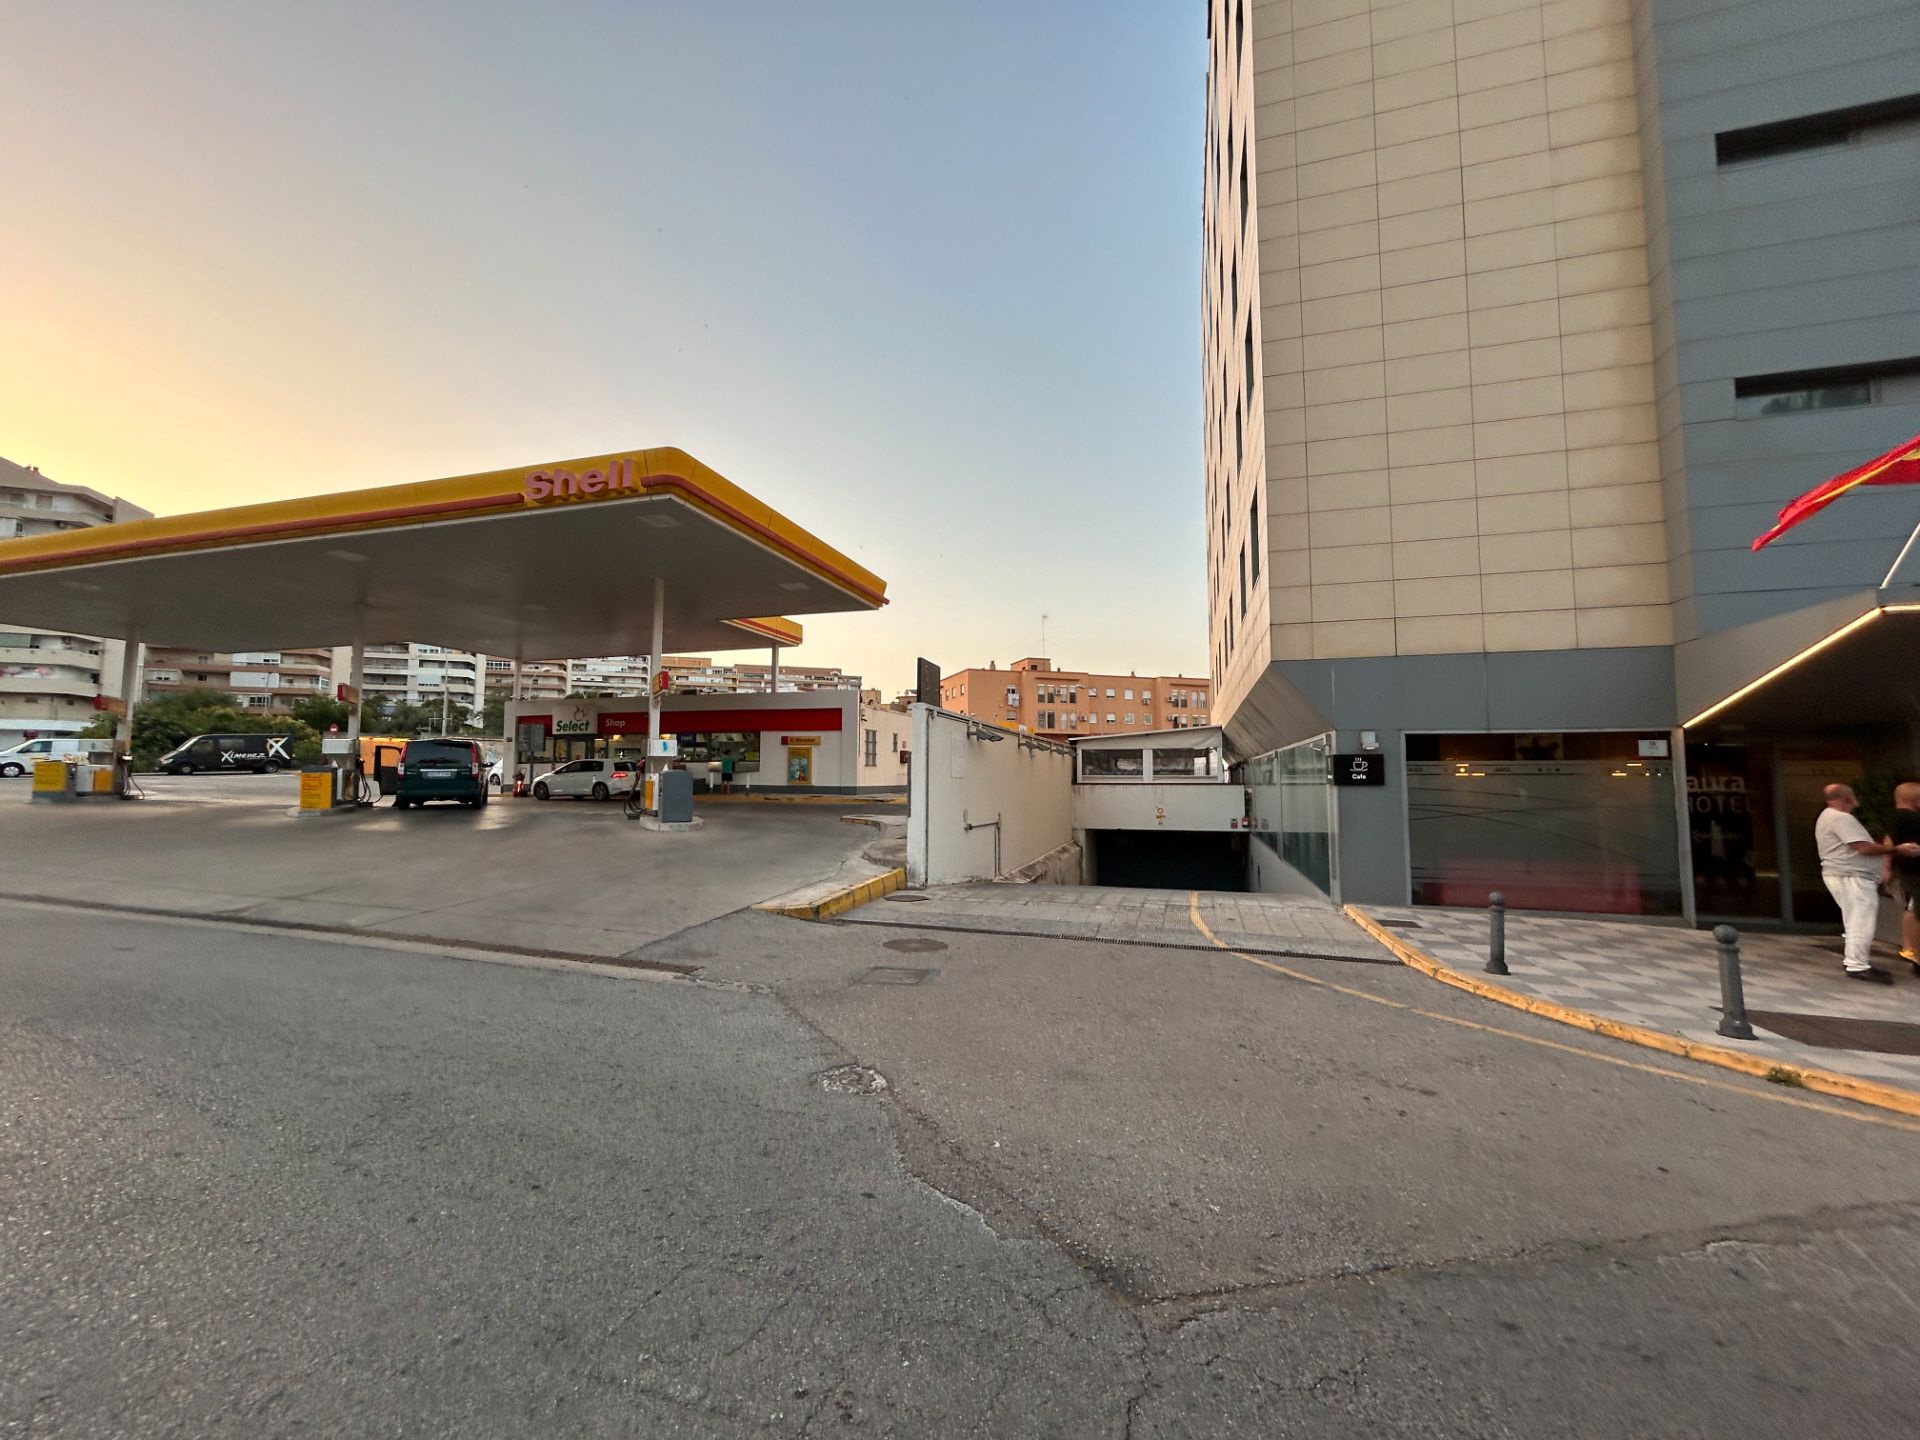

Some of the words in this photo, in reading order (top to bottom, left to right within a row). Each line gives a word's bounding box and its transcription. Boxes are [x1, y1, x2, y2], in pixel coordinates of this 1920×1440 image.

[526, 458, 635, 502] Shell
[555, 720, 590, 732] Select
[605, 719, 625, 728] Shop
